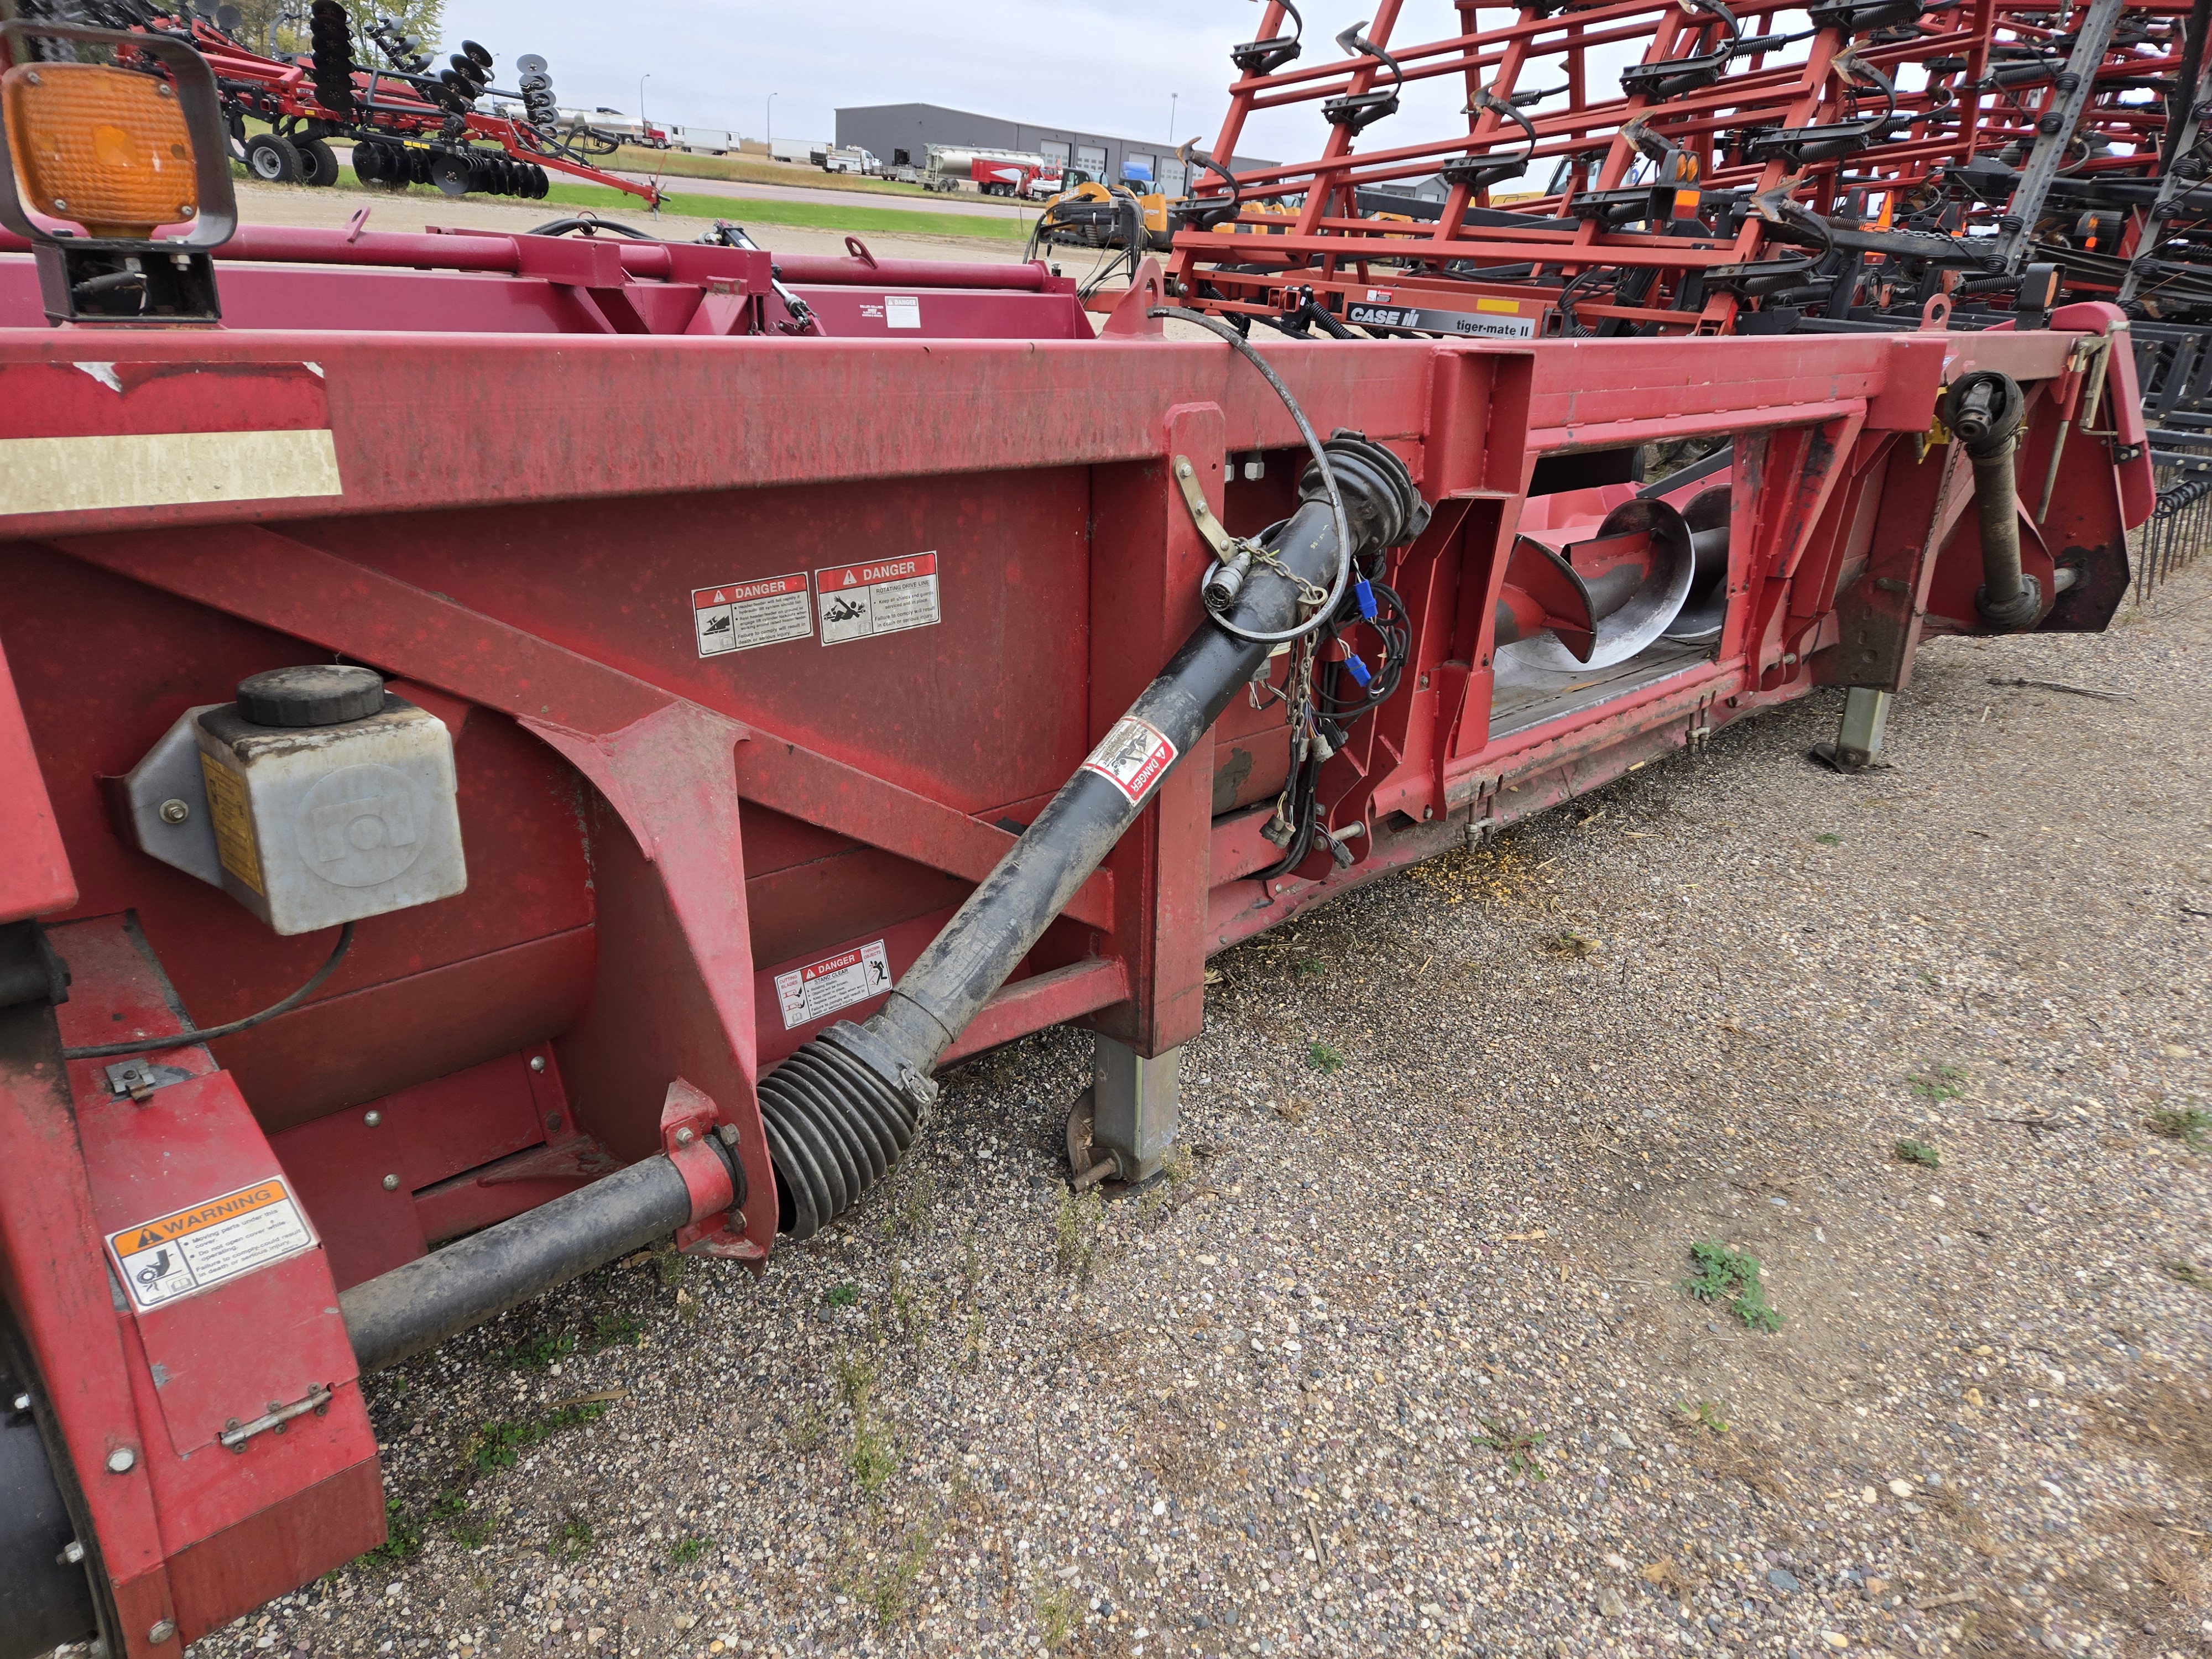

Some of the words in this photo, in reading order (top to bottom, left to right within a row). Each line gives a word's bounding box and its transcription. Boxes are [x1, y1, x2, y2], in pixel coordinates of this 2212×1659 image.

[1058, 186, 1079, 202] CASE
[1350, 307, 1400, 325] CASE
[1456, 320, 1516, 336] tiger-mate
[1520, 326, 1529, 337] II
[863, 561, 915, 581] DANGER
[735, 581, 785, 598] DANGER
[877, 585, 900, 593] ROTATING
[1129, 758, 1159, 792] DANGER
[863, 946, 880, 954] THROWN
[864, 950, 881, 959] OBJECTS
[818, 954, 855, 974] DANGER
[779, 975, 797, 984] CUTTING
[781, 980, 797, 989] BLADES
[815, 975, 831, 984] STAND
[832, 969, 848, 977] CLEAR
[161, 1188, 273, 1234] WARNING
[191, 1231, 220, 1244] Moving
[220, 1223, 240, 1233] parts
[241, 1215, 263, 1225] under
[224, 1237, 244, 1246] open
[244, 1228, 265, 1238] cover
[267, 1221, 286, 1230] while
[194, 1238, 217, 1248] cover.
[195, 1260, 222, 1272] Failure
[232, 1245, 259, 1258] comply
[259, 1237, 280, 1248] could
[280, 1229, 302, 1239] result
[201, 1245, 239, 1261] operating.
[207, 1264, 229, 1274] death
[240, 1249, 268, 1261] serious
[269, 1239, 291, 1250] injury.
